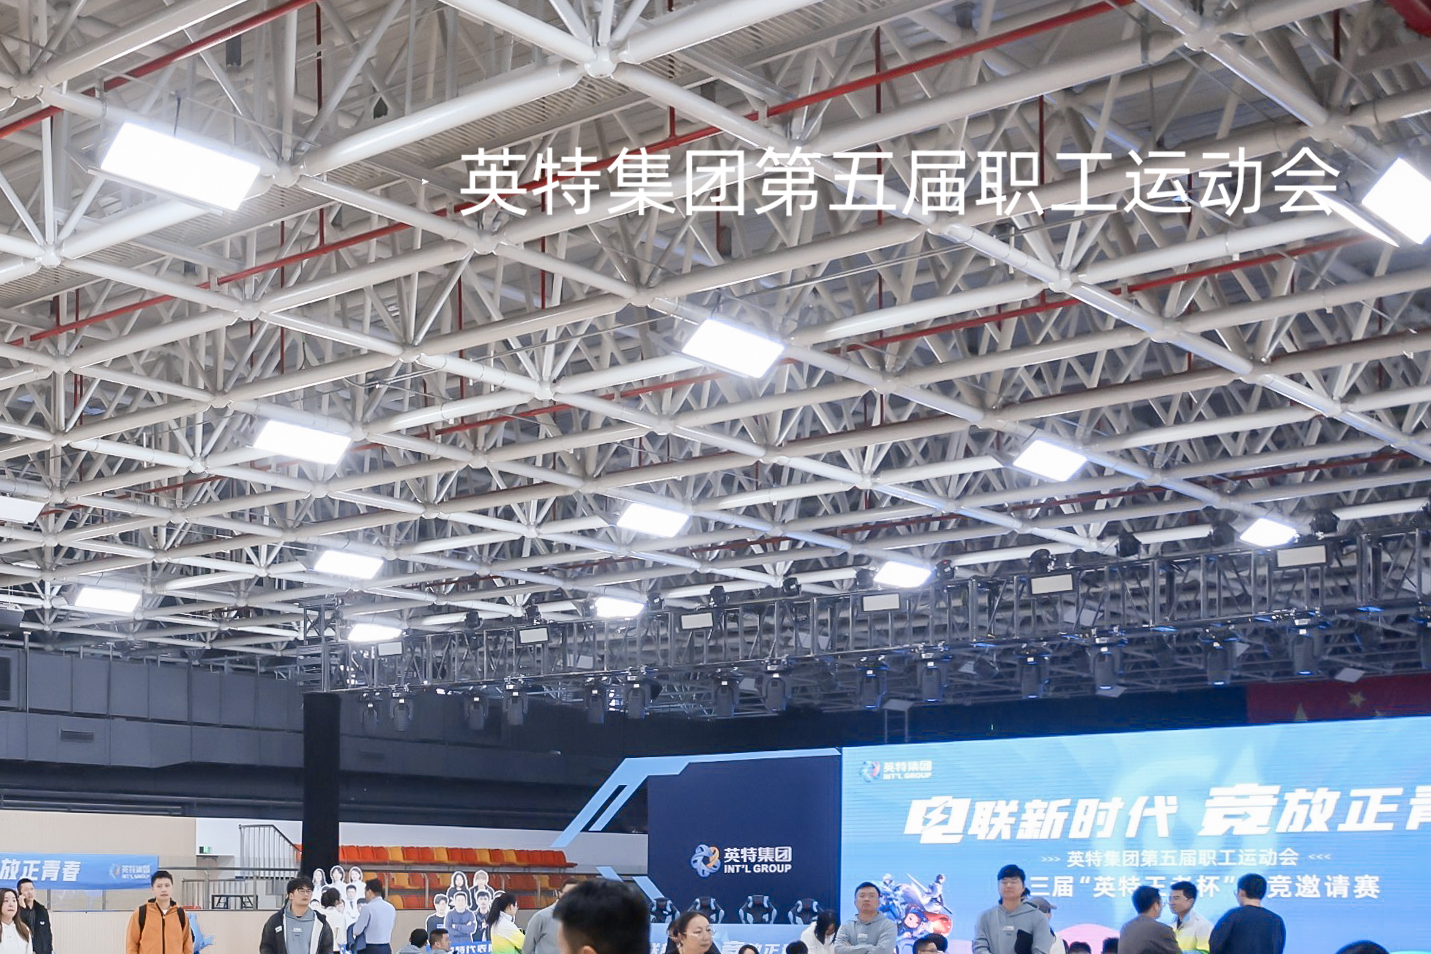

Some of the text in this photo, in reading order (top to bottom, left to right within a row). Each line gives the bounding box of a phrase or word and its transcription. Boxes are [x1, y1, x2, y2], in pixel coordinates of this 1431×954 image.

[883, 760, 932, 773] 英特集团
[904, 771, 932, 779] GROUP
[904, 796, 1178, 843] 电联新时代
[723, 846, 793, 863] 英特集团
[1067, 848, 1299, 868] 英特集团第五届职工运动会
[724, 864, 792, 874] INT'L GROUP
